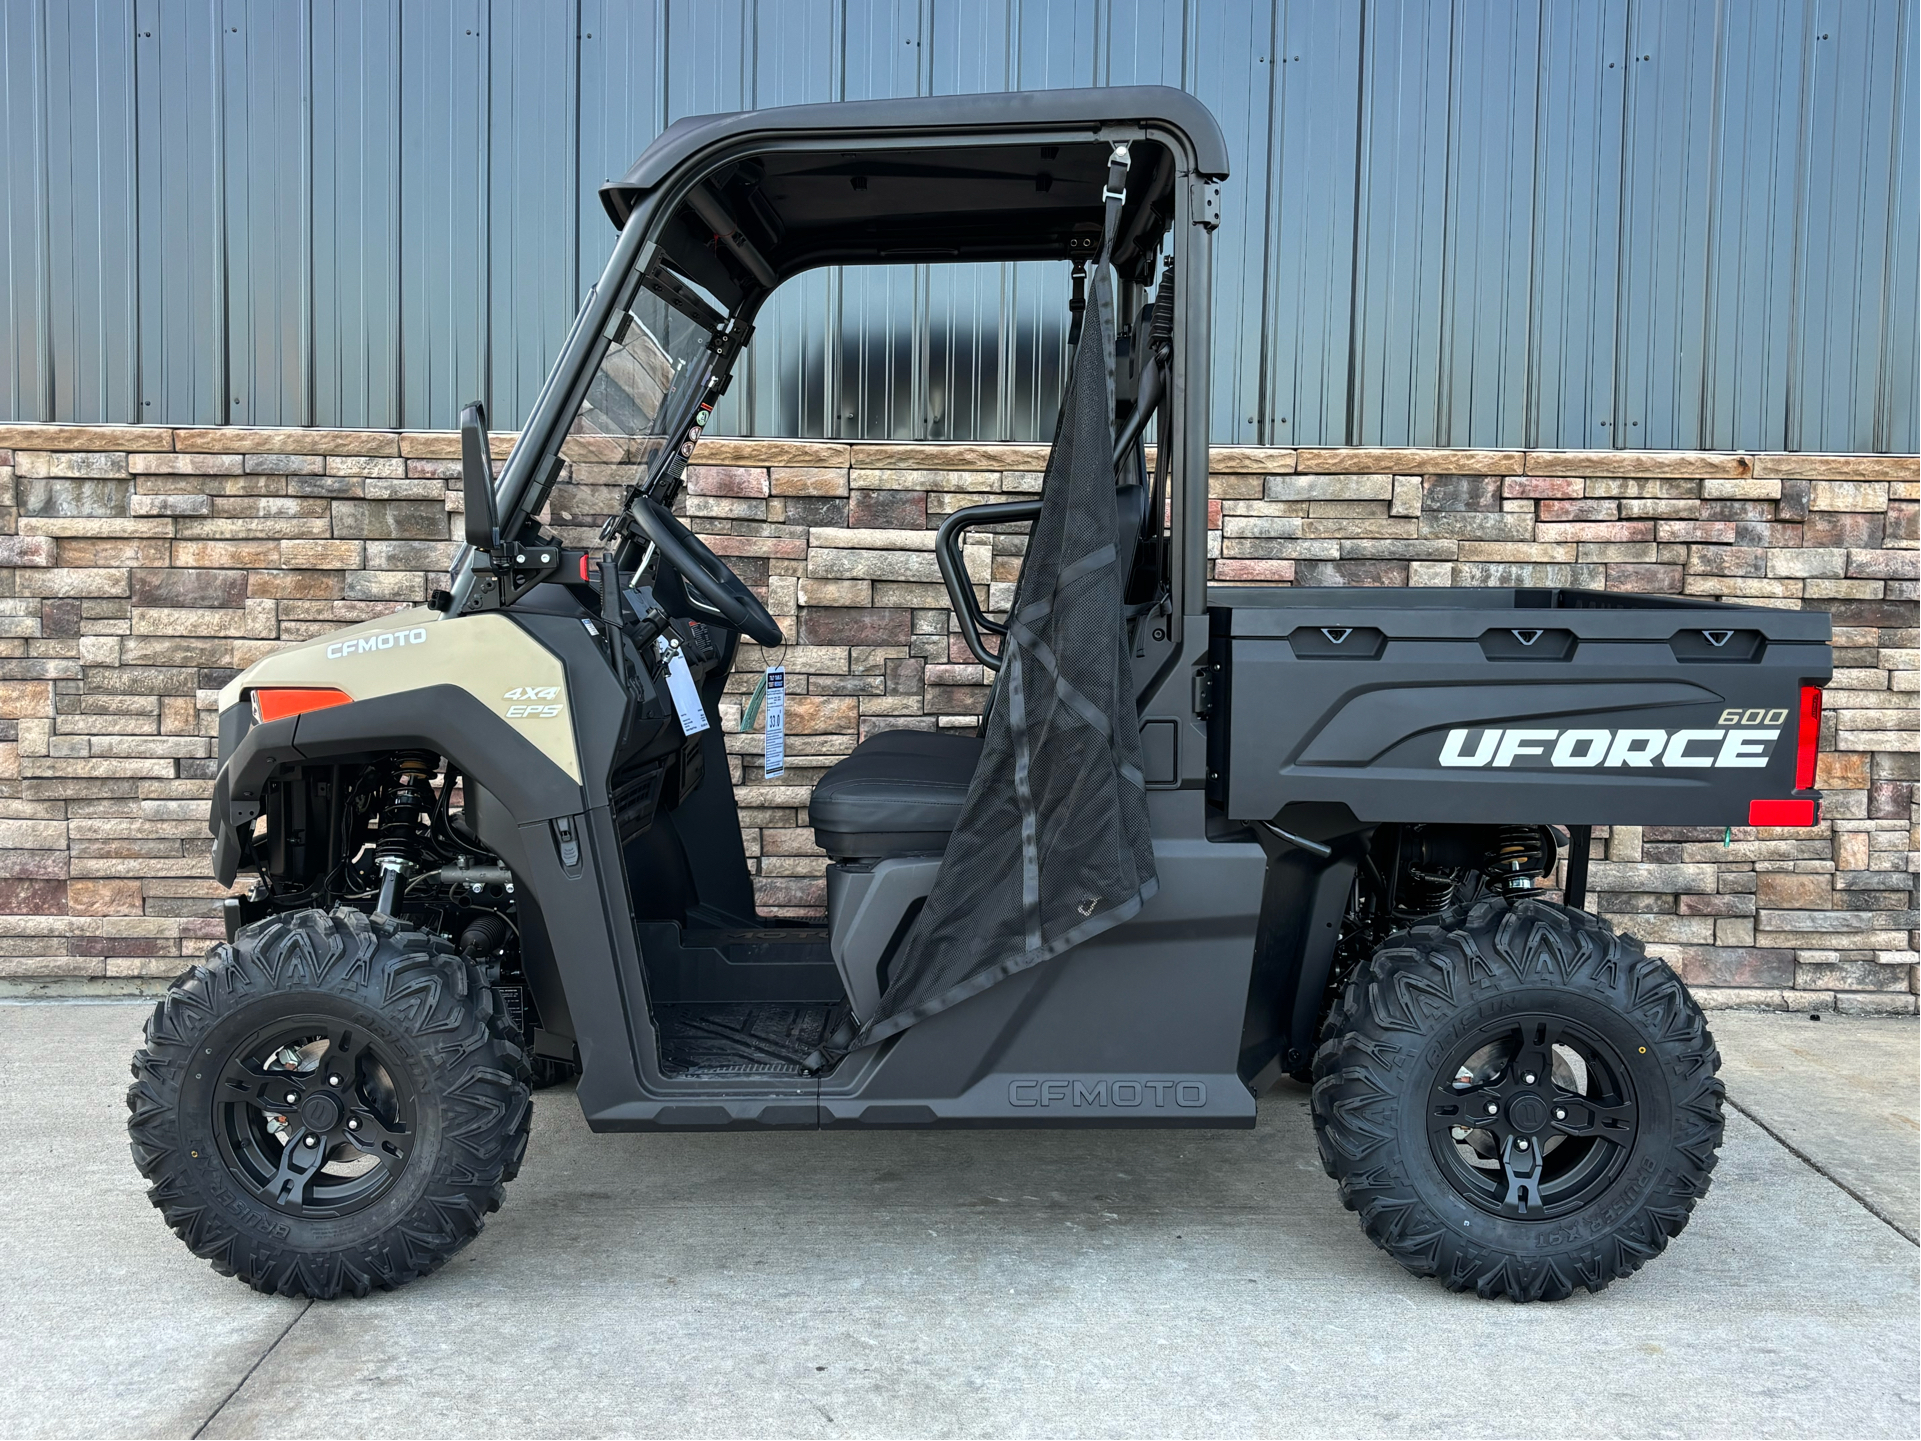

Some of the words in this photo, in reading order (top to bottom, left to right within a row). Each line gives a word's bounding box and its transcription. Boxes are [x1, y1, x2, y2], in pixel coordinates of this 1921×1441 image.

[326, 628, 427, 660] CFMOTO
[502, 686, 560, 701] 4X4
[504, 704, 563, 719] EPS
[1717, 709, 1789, 725] 600
[1438, 728, 1781, 768] UFORCE
[1008, 1080, 1207, 1107] CFMOTO
[209, 1174, 290, 1240] BRUISER
[1582, 1155, 1658, 1233] BRUISER
